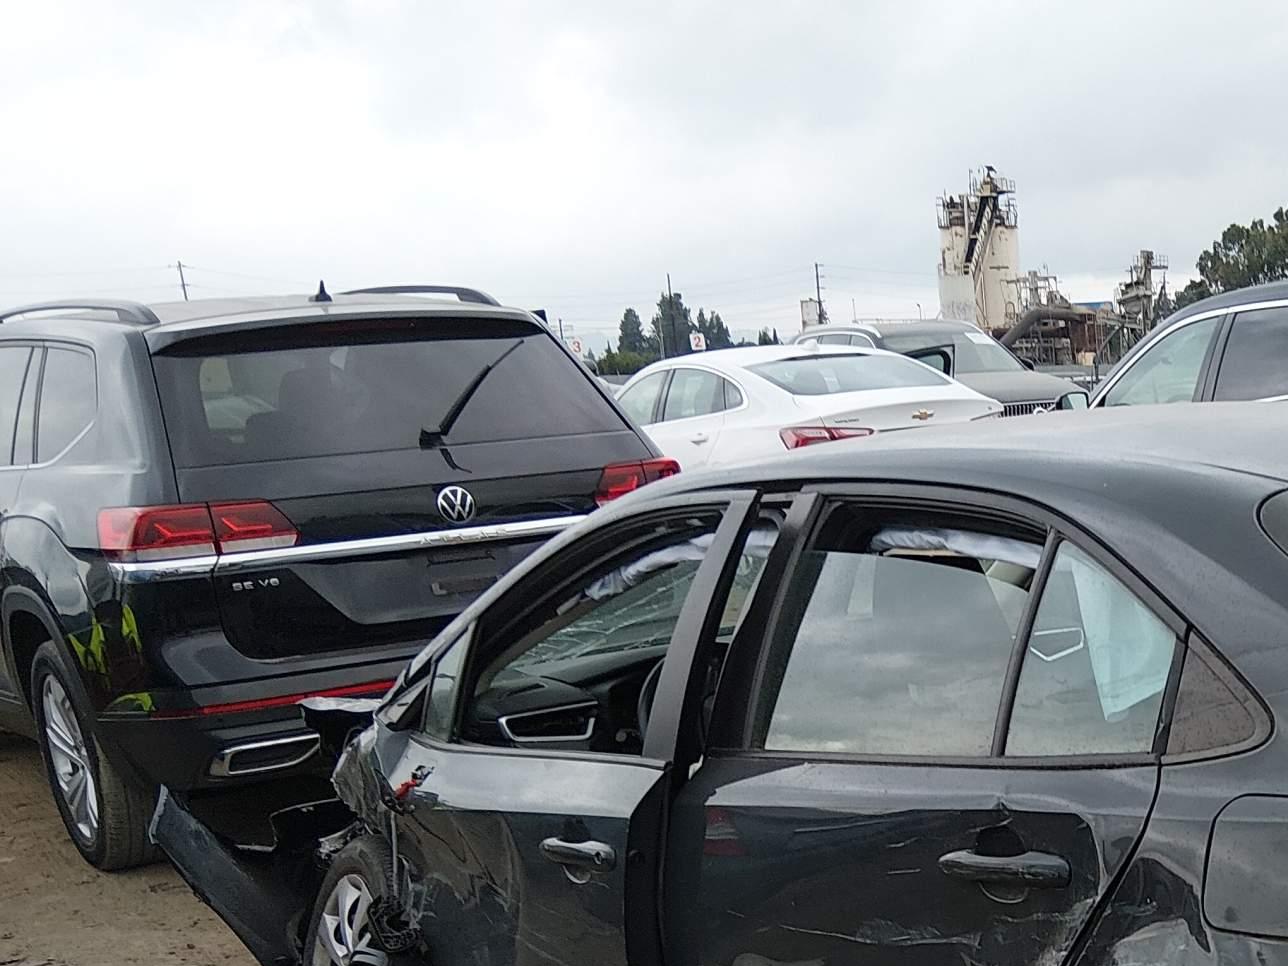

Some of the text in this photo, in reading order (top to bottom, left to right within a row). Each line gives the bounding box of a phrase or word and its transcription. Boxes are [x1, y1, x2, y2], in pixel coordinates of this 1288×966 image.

[569, 336, 582, 354] 3
[693, 335, 703, 348] 2
[231, 580, 255, 592] SE
